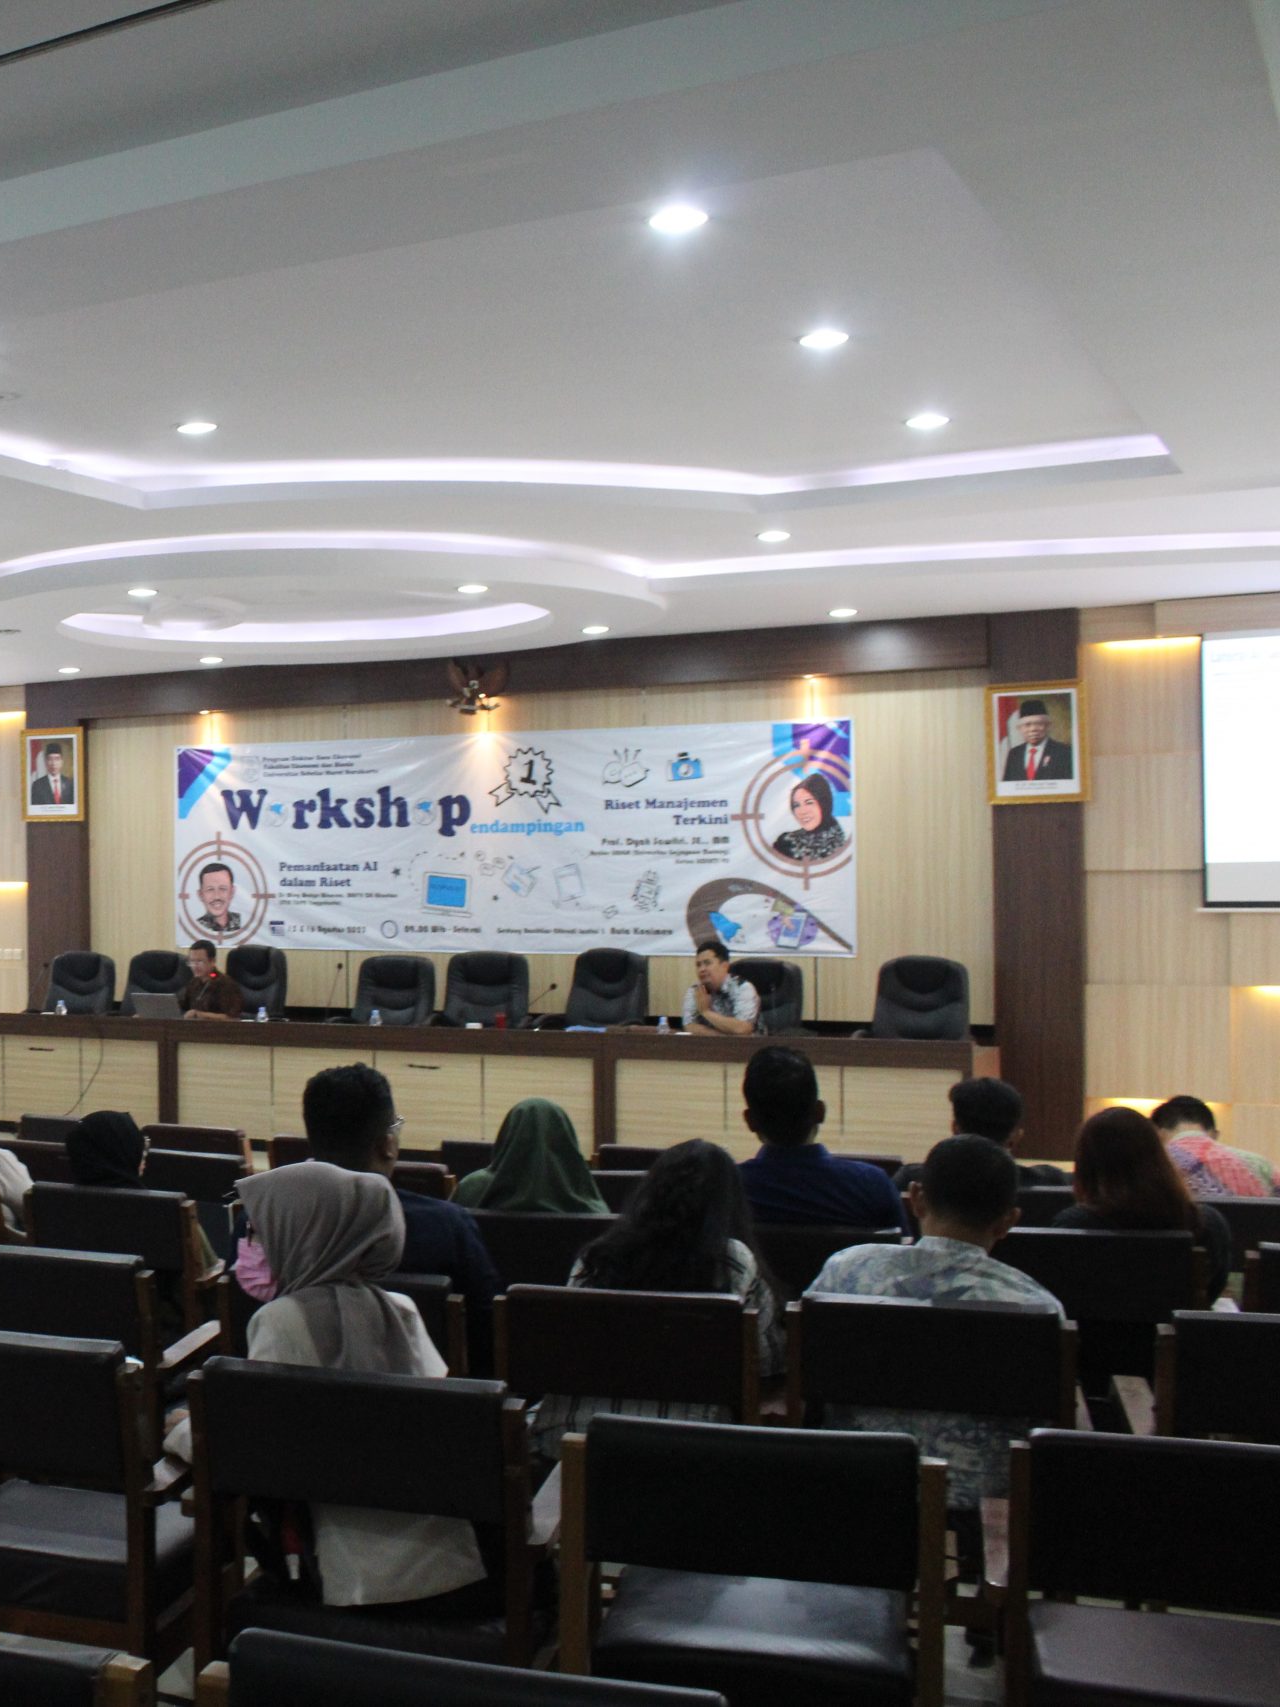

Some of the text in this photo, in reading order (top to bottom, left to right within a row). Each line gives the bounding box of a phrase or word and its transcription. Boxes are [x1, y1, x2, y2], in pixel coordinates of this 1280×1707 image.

[520, 760, 536, 785] 1
[604, 798, 728, 810] Riset Manajemen
[221, 785, 472, 837] Workshop
[673, 814, 729, 825] Terkini
[279, 861, 378, 872] Pemanfaatan AI
[280, 876, 351, 887] dalam Riset
